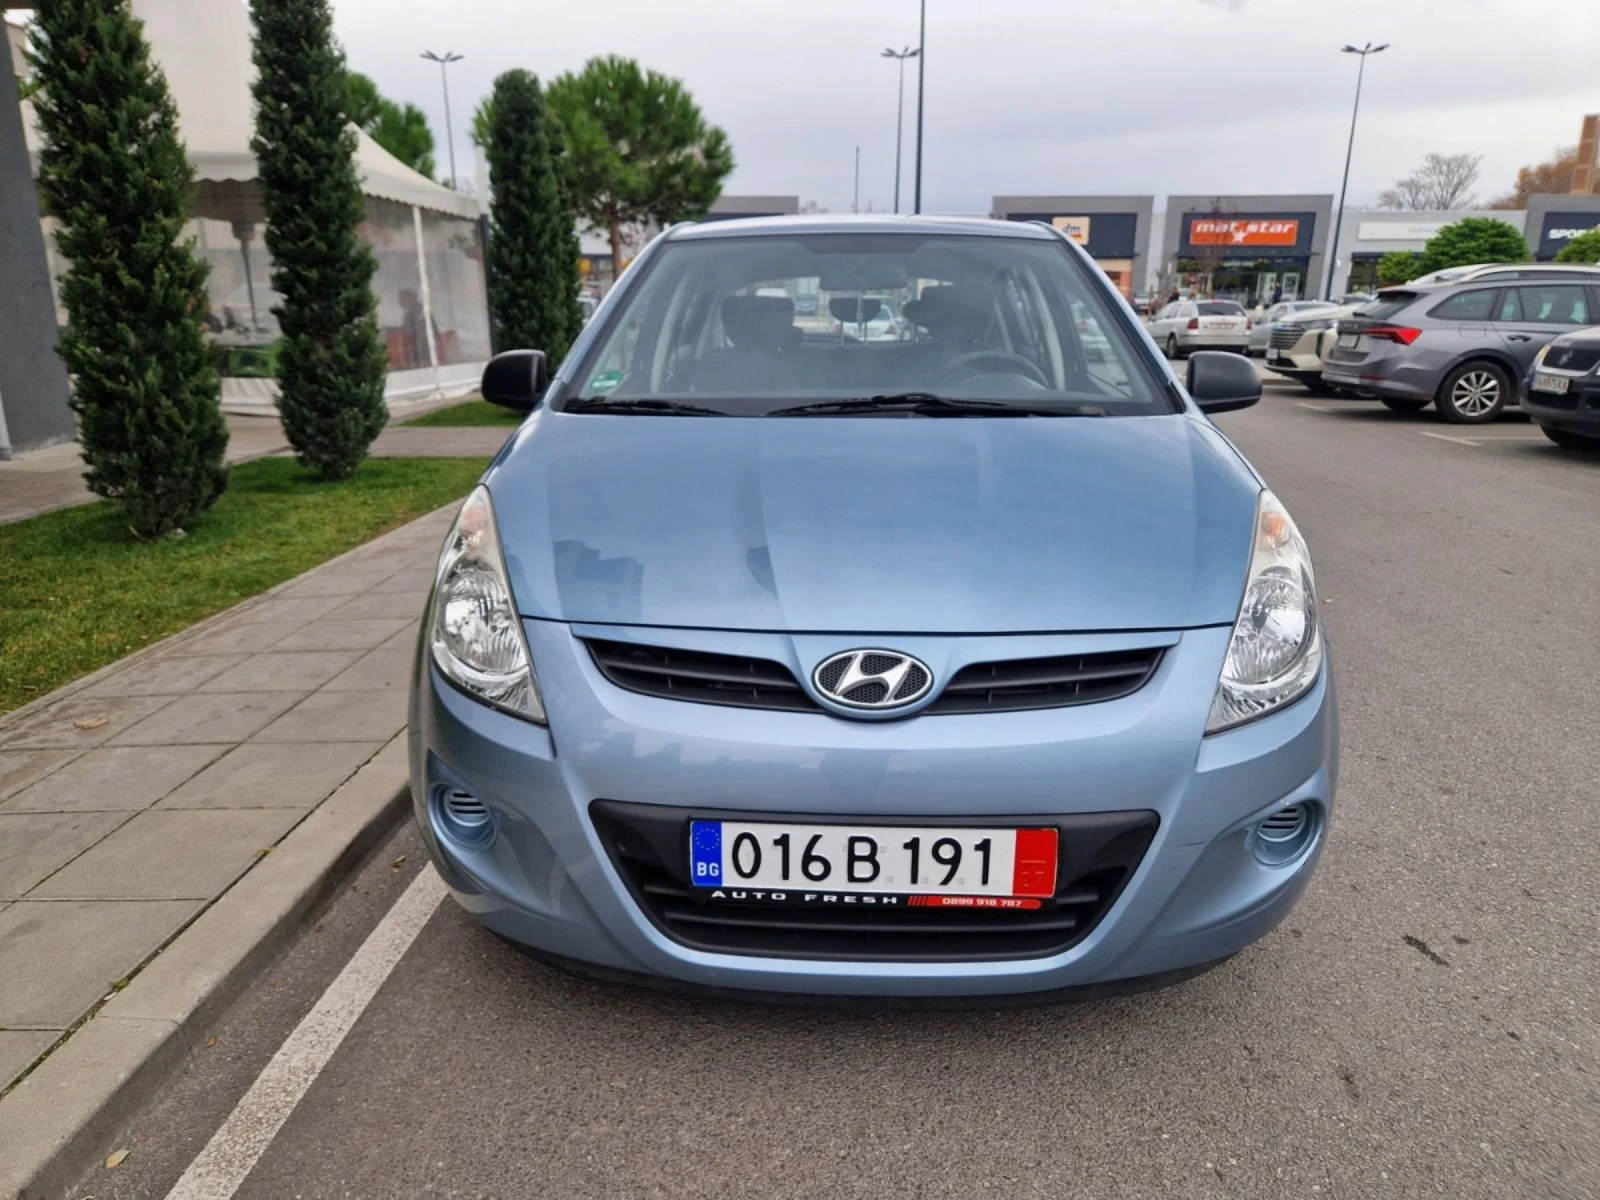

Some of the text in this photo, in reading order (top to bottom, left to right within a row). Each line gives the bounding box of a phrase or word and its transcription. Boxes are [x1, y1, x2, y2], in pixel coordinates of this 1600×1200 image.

[1062, 223, 1081, 234] dm
[697, 862, 719, 876] BG
[711, 890, 787, 900] AUTO
[804, 893, 898, 904] FRESH
